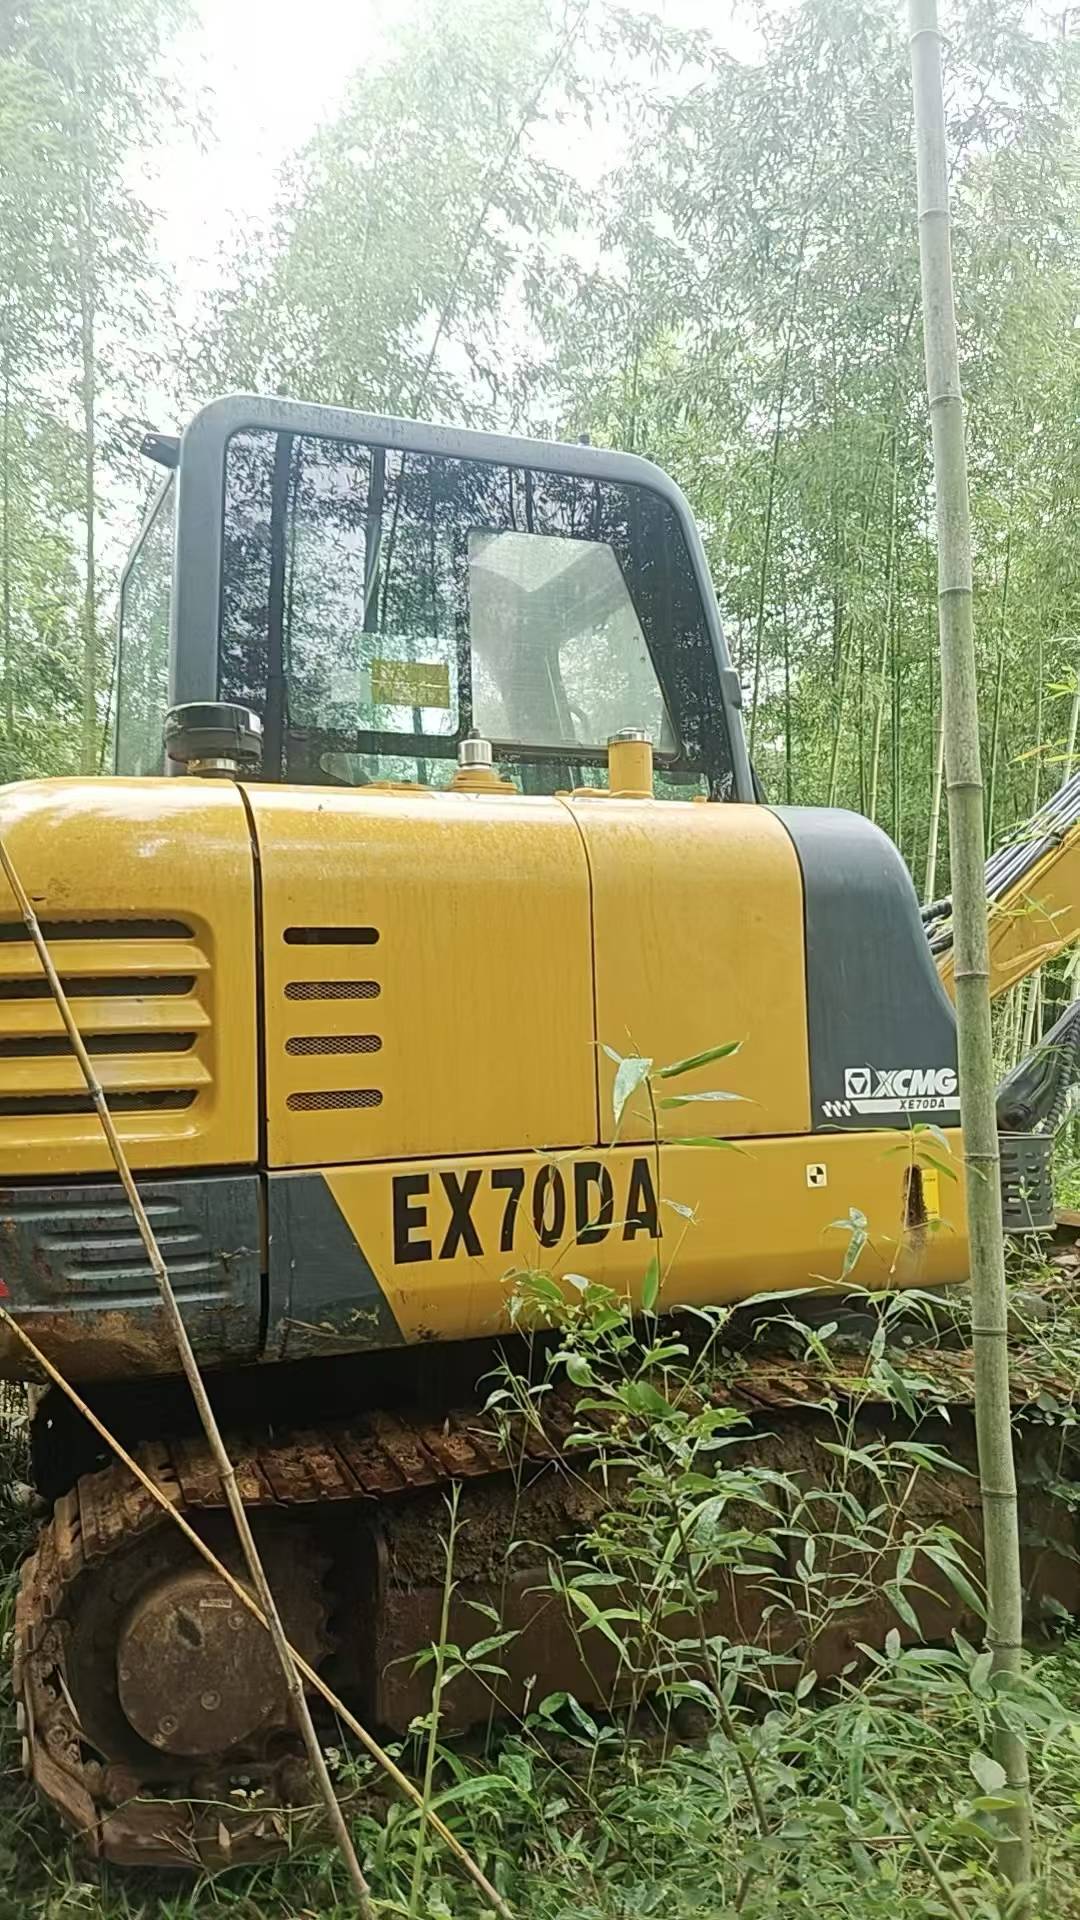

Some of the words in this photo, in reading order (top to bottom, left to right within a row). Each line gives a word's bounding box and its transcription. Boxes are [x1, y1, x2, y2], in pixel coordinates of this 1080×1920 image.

[872, 1067, 958, 1097] XCMG
[899, 1098, 946, 1110] XE70DA
[392, 1157, 663, 1264] EX70DA
